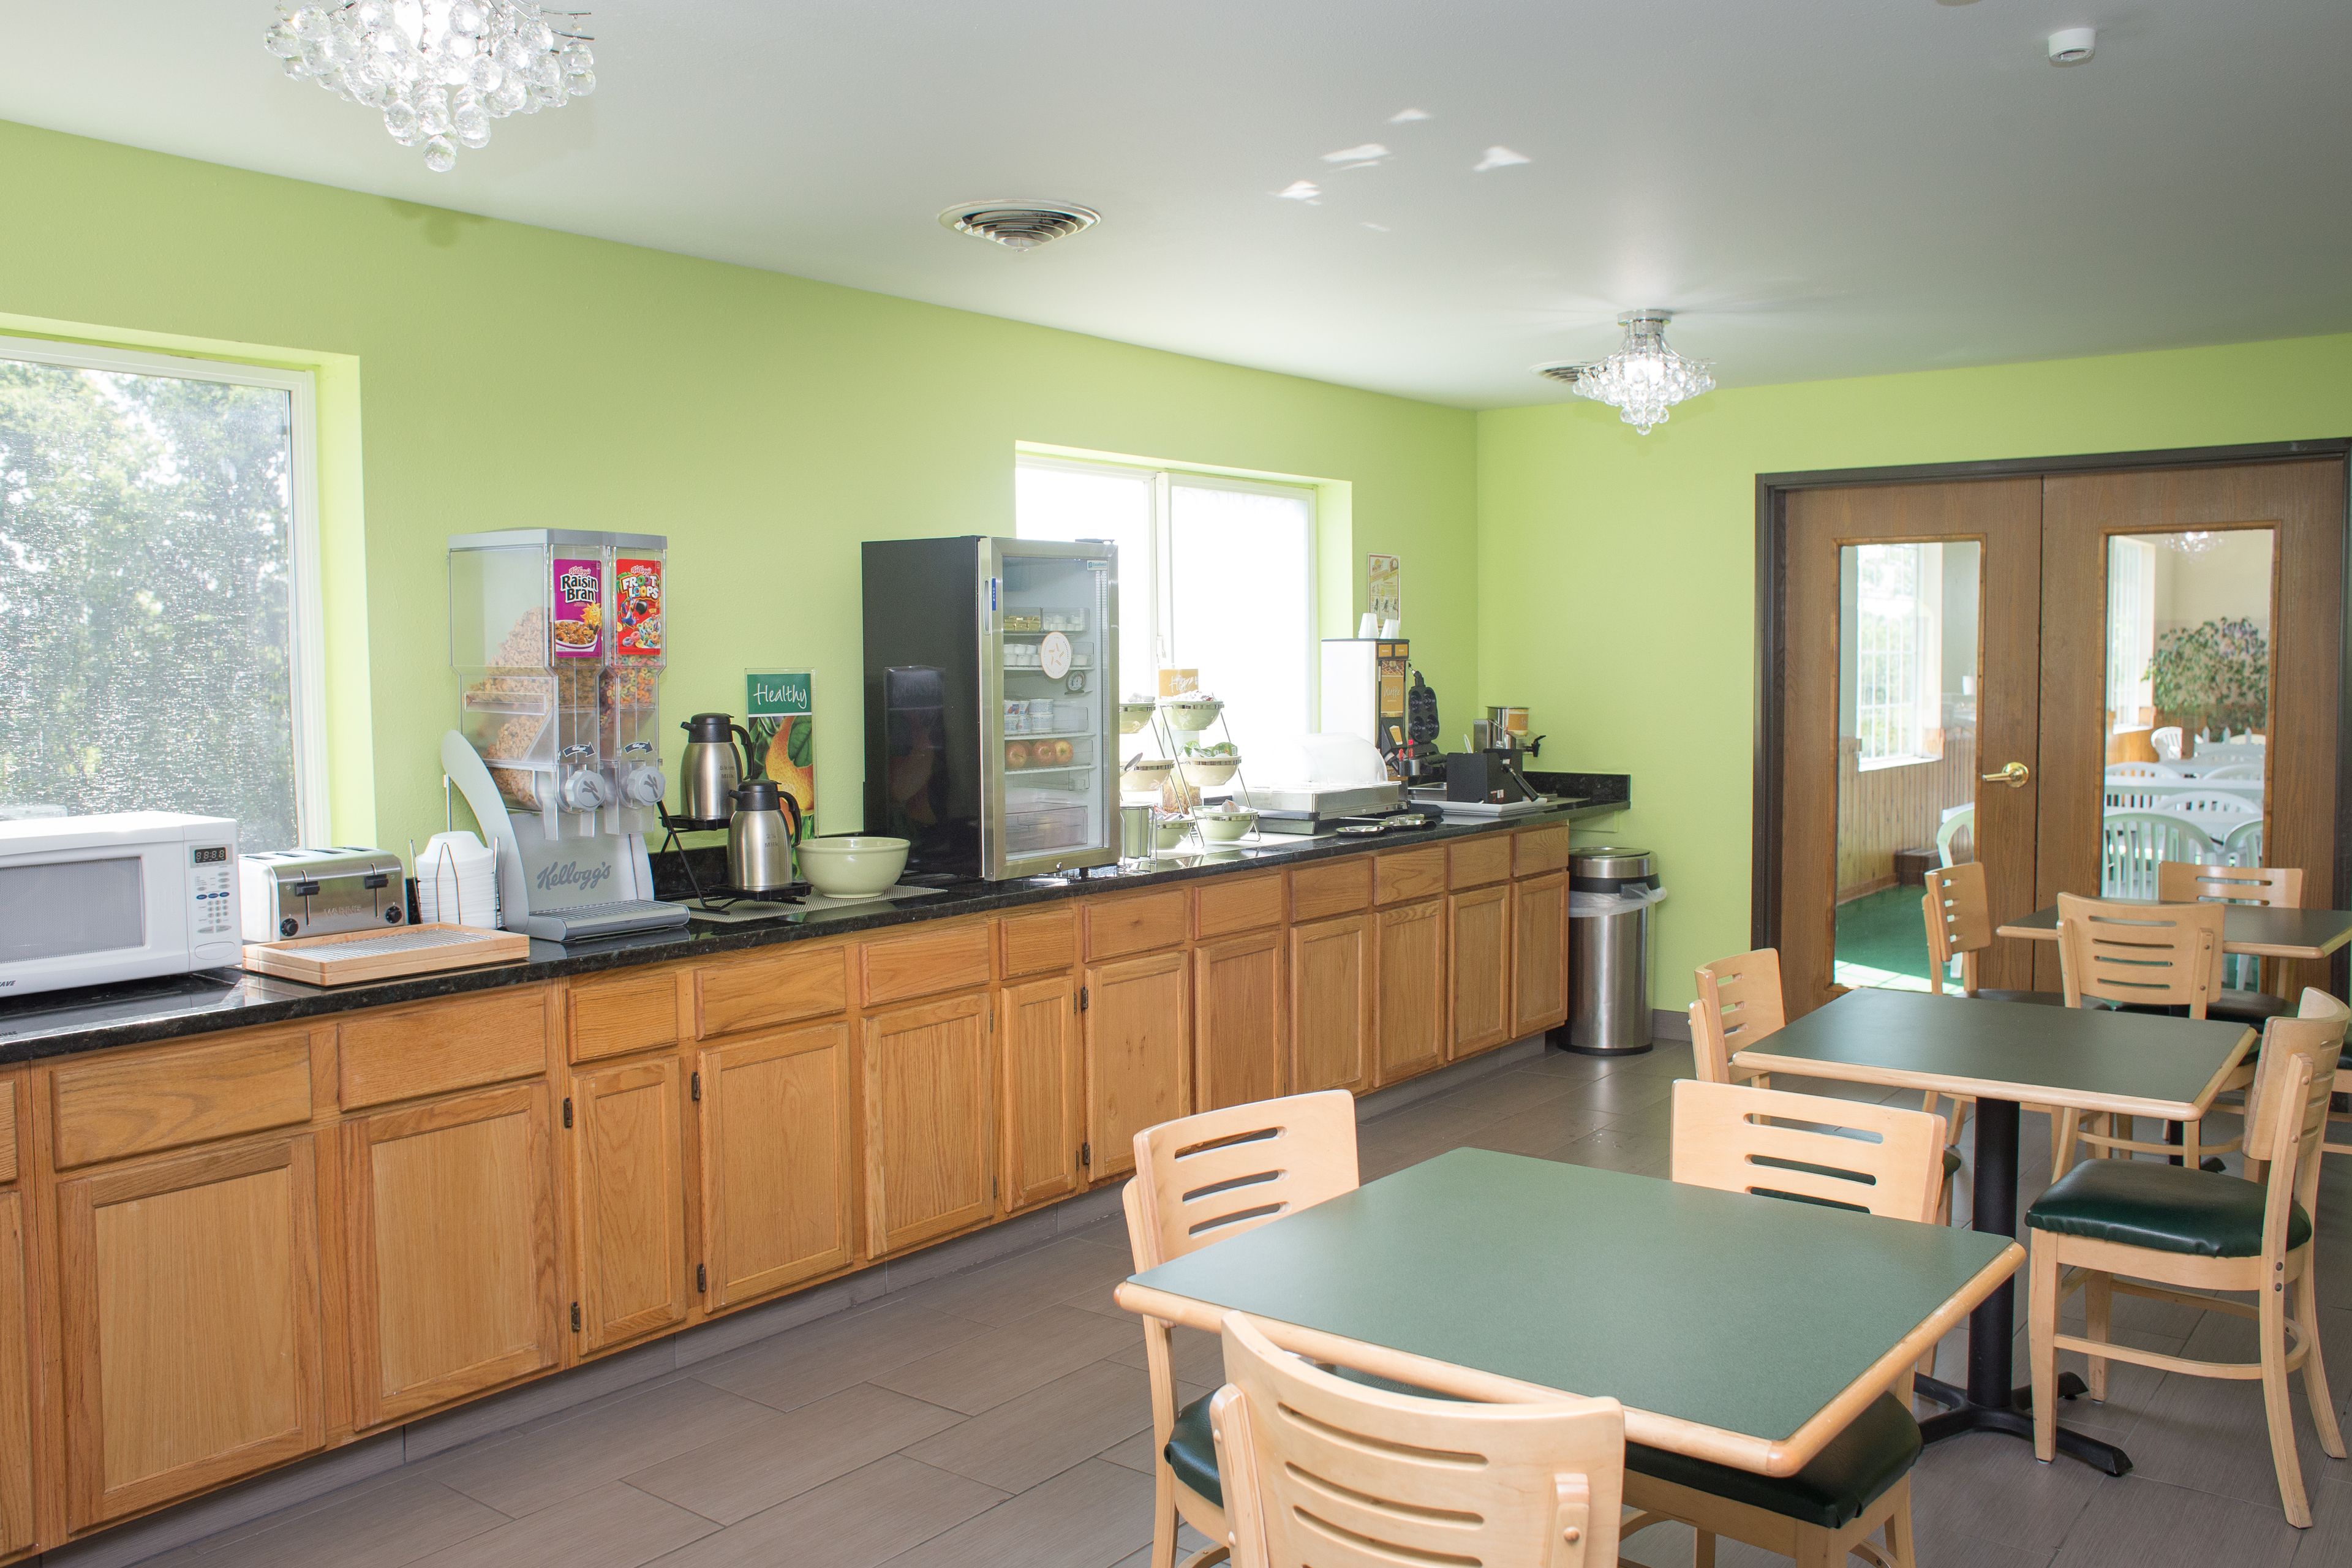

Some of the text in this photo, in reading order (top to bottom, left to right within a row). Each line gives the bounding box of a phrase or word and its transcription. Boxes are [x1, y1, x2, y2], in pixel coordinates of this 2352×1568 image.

[562, 575, 598, 590] Raisin
[622, 575, 657, 590] FROOT
[567, 588, 595, 601] Bran
[629, 586, 659, 600] LOOPS
[753, 683, 807, 709] Healthy
[537, 861, 612, 891] Kellogg's
